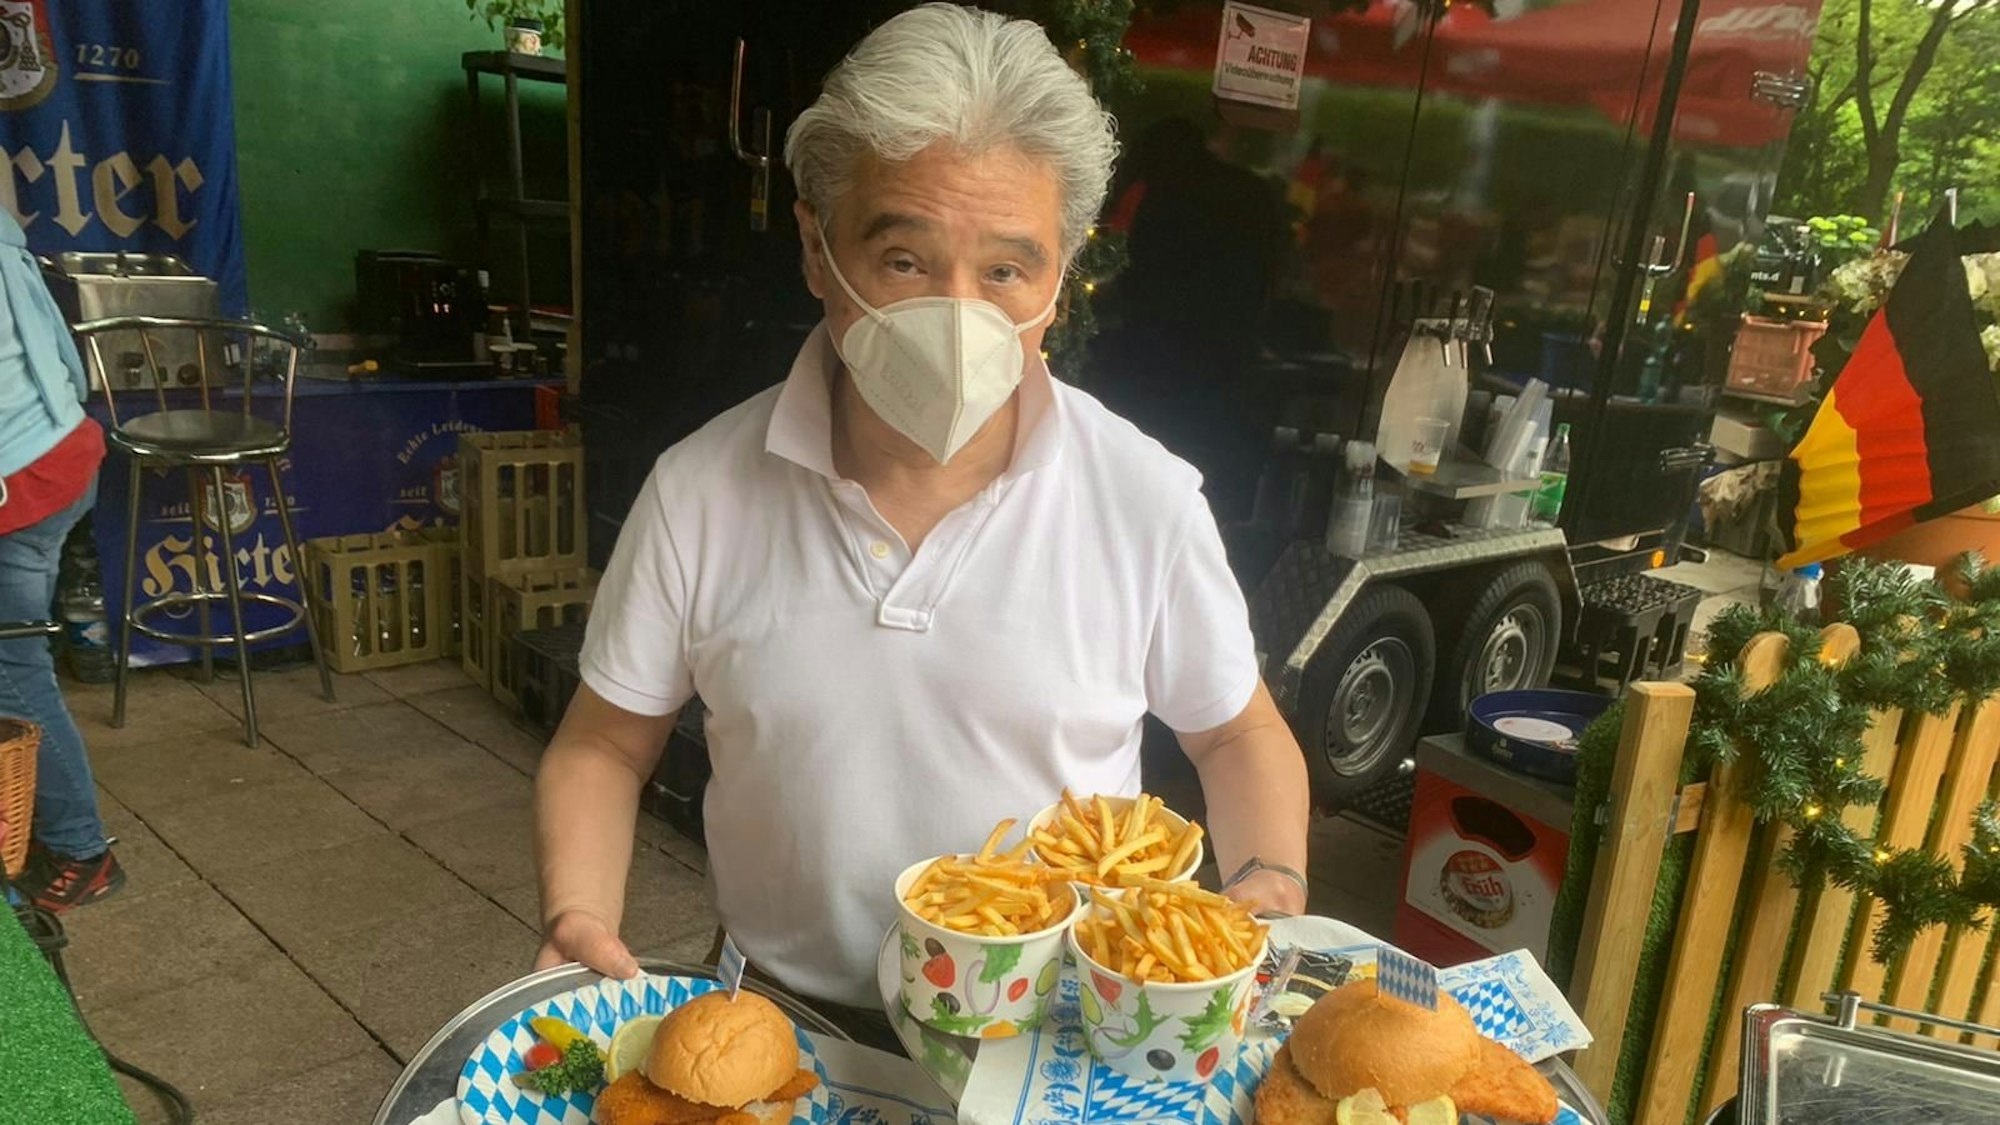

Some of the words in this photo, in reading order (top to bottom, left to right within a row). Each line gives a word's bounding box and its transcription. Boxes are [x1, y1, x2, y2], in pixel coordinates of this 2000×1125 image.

[76, 44, 140, 68] 1270
[1247, 45, 1298, 72] ACHTUNG
[400, 486, 428, 499] seit
[161, 502, 192, 517] seit
[265, 496, 295, 508] 120
